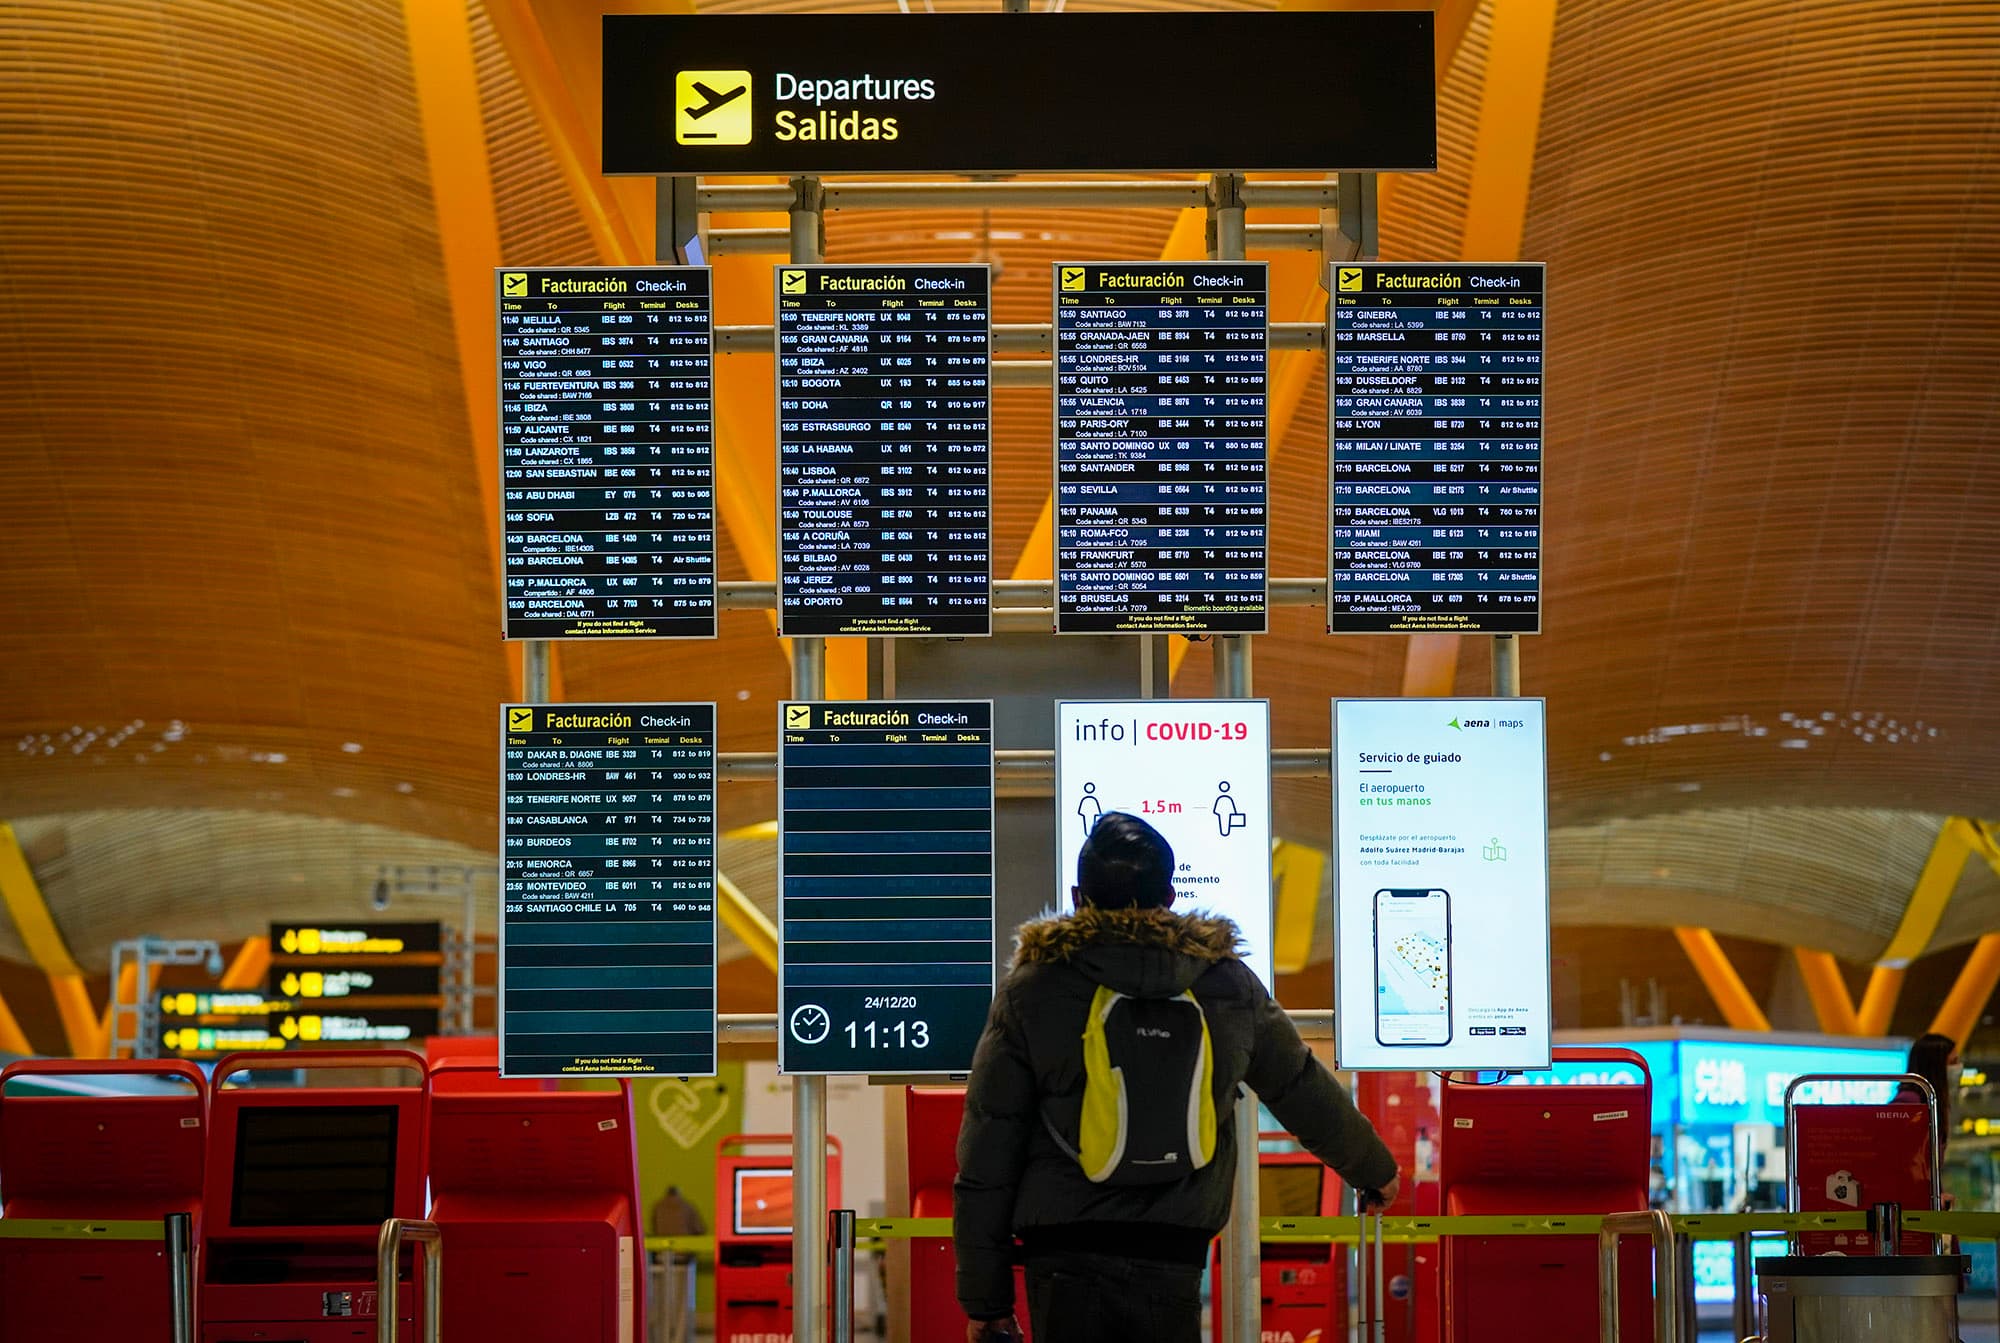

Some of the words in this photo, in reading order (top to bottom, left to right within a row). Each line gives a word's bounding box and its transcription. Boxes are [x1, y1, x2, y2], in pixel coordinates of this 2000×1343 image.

[775, 72, 936, 106] Departures
[775, 110, 898, 141] Salidas
[820, 274, 906, 291] Facturación
[914, 278, 965, 289] Check-in
[1099, 272, 1184, 288] Facturación
[1193, 275, 1244, 286] Check-in
[1376, 273, 1461, 289] Facturación
[1470, 276, 1520, 288] Check-in
[541, 277, 627, 294] Facturación
[636, 280, 686, 292] Check-in
[882, 299, 904, 307] Flight
[919, 299, 944, 307] Terminal
[954, 299, 977, 307] Desks
[1061, 297, 1079, 305] Time
[1161, 296, 1182, 305] Flight
[1197, 296, 1223, 304] Terminal
[1233, 296, 1255, 304] Desks
[1338, 298, 1356, 306] Time
[1438, 297, 1459, 306] Flight
[1474, 297, 1499, 305] Terminal
[1509, 297, 1532, 305] Desks
[547, 302, 557, 310] To
[604, 302, 625, 310] Flight
[676, 301, 699, 309] Desks
[802, 314, 844, 322] TENERIFE
[1357, 311, 1397, 319] GINEBRA
[523, 316, 561, 324] MELILLA
[802, 335, 827, 343] GRAN
[829, 335, 869, 343] CANARIA
[1080, 332, 1149, 341] GRANADA-JAEN
[1357, 333, 1405, 341] MARSELLA
[523, 338, 569, 346] SANTIAGO
[802, 358, 824, 366] IBIZA
[1080, 355, 1139, 363] LONDRES-HR
[1357, 356, 1399, 364] TENERIFE
[1401, 356, 1430, 364] NORTE
[524, 361, 547, 369] VIGO
[802, 379, 841, 387] BOGOTA
[1080, 376, 1108, 385] QUITO
[1356, 377, 1417, 385] DUSSELDORF
[524, 382, 599, 390] FUERTEVENTURA
[802, 401, 828, 409] DOHA
[1080, 398, 1124, 406] VALENCIA
[1356, 399, 1382, 407] GRAN
[1384, 399, 1423, 407] CANARIA
[524, 404, 548, 412] IBIZA
[802, 423, 871, 431] ESTRASBURGO
[1080, 420, 1129, 428] PARIS-ORY
[1356, 420, 1381, 429] LYON
[524, 426, 569, 434] ALICANTE
[802, 445, 814, 453] LA
[816, 445, 853, 453] HABANA
[1080, 442, 1110, 450] SANTO
[1112, 442, 1154, 450] DOMINGO
[1356, 443, 1383, 451] MILAN
[1390, 443, 1422, 451] LINATE
[525, 448, 580, 456] LANZAROTE
[802, 467, 836, 475] LISBOA
[1080, 464, 1135, 472] SANTANDER
[1356, 464, 1411, 473] BARCELONA
[526, 469, 544, 478] SAN
[546, 469, 597, 478] SEBASTIAN
[803, 489, 861, 497] P.MALLORCA
[1081, 486, 1117, 494] SEVILLA
[1356, 486, 1411, 494] BARCELONA
[547, 491, 575, 499] DHABI
[804, 510, 853, 518] TOULOUSE
[1081, 508, 1118, 516] PANAMA
[1356, 508, 1411, 516] BARCELONA
[527, 513, 554, 521] SOFIA
[812, 531, 850, 540] CORUÑA
[1081, 529, 1128, 537] ROMA-FCO
[1355, 530, 1380, 538] MIAMI
[527, 535, 583, 543] BARCELONA
[804, 554, 837, 562] BILBAO
[1081, 551, 1134, 559] FRANKFURT
[1355, 551, 1410, 560] BARCELONA
[527, 557, 584, 565] BARCELONA
[804, 576, 833, 584] JEREZ
[1081, 573, 1110, 581] SANTO
[1112, 573, 1154, 581] DOMINGO
[1355, 573, 1410, 581] BARCELONA
[528, 579, 587, 587] P.MALLORCA
[804, 598, 843, 606] OPORTO
[1081, 595, 1129, 603] BRUSELAS
[1355, 595, 1412, 603] P.MALLORCA
[529, 600, 584, 609] BARCELONA
[546, 712, 632, 729] Facturación
[640, 716, 690, 727] Check-in
[824, 710, 909, 726] Facturación
[917, 713, 968, 725] Check-in
[1464, 720, 1490, 728] aena
[1499, 719, 1524, 729] maps
[1075, 719, 1124, 741] info
[1146, 722, 1248, 740] COVID-19
[552, 737, 562, 745] To
[608, 737, 629, 745] Flight
[527, 751, 558, 759] DAKAR
[570, 751, 602, 759] DIAGNE
[1359, 753, 1403, 763] Servicio
[1407, 752, 1420, 763] de
[1423, 752, 1462, 764] guiado
[527, 772, 586, 781] LONDRES-HR
[1360, 783, 1368, 793] El
[1371, 784, 1425, 794] aeropuerto
[528, 795, 569, 803] TENERIFE
[571, 795, 601, 803] NORTE
[1360, 797, 1373, 806] en
[1377, 797, 1393, 806] tus
[1396, 797, 1431, 806] manos
[527, 816, 588, 825] CASABLANCA
[527, 838, 571, 846] BURDEOS
[1399, 835, 1409, 843] por
[1419, 835, 1456, 843] aeropuerto
[1412, 846, 1465, 854] Madrid-Barajas
[527, 860, 572, 868] MENORCA
[1179, 863, 1191, 871] de
[1173, 875, 1220, 884] momento
[527, 882, 586, 890] MONTEVIDEO
[527, 904, 573, 912] SANTIAGO
[575, 904, 601, 912] CHILE
[864, 996, 917, 1009] 24/12/20
[844, 1020, 930, 1049] 11:13
